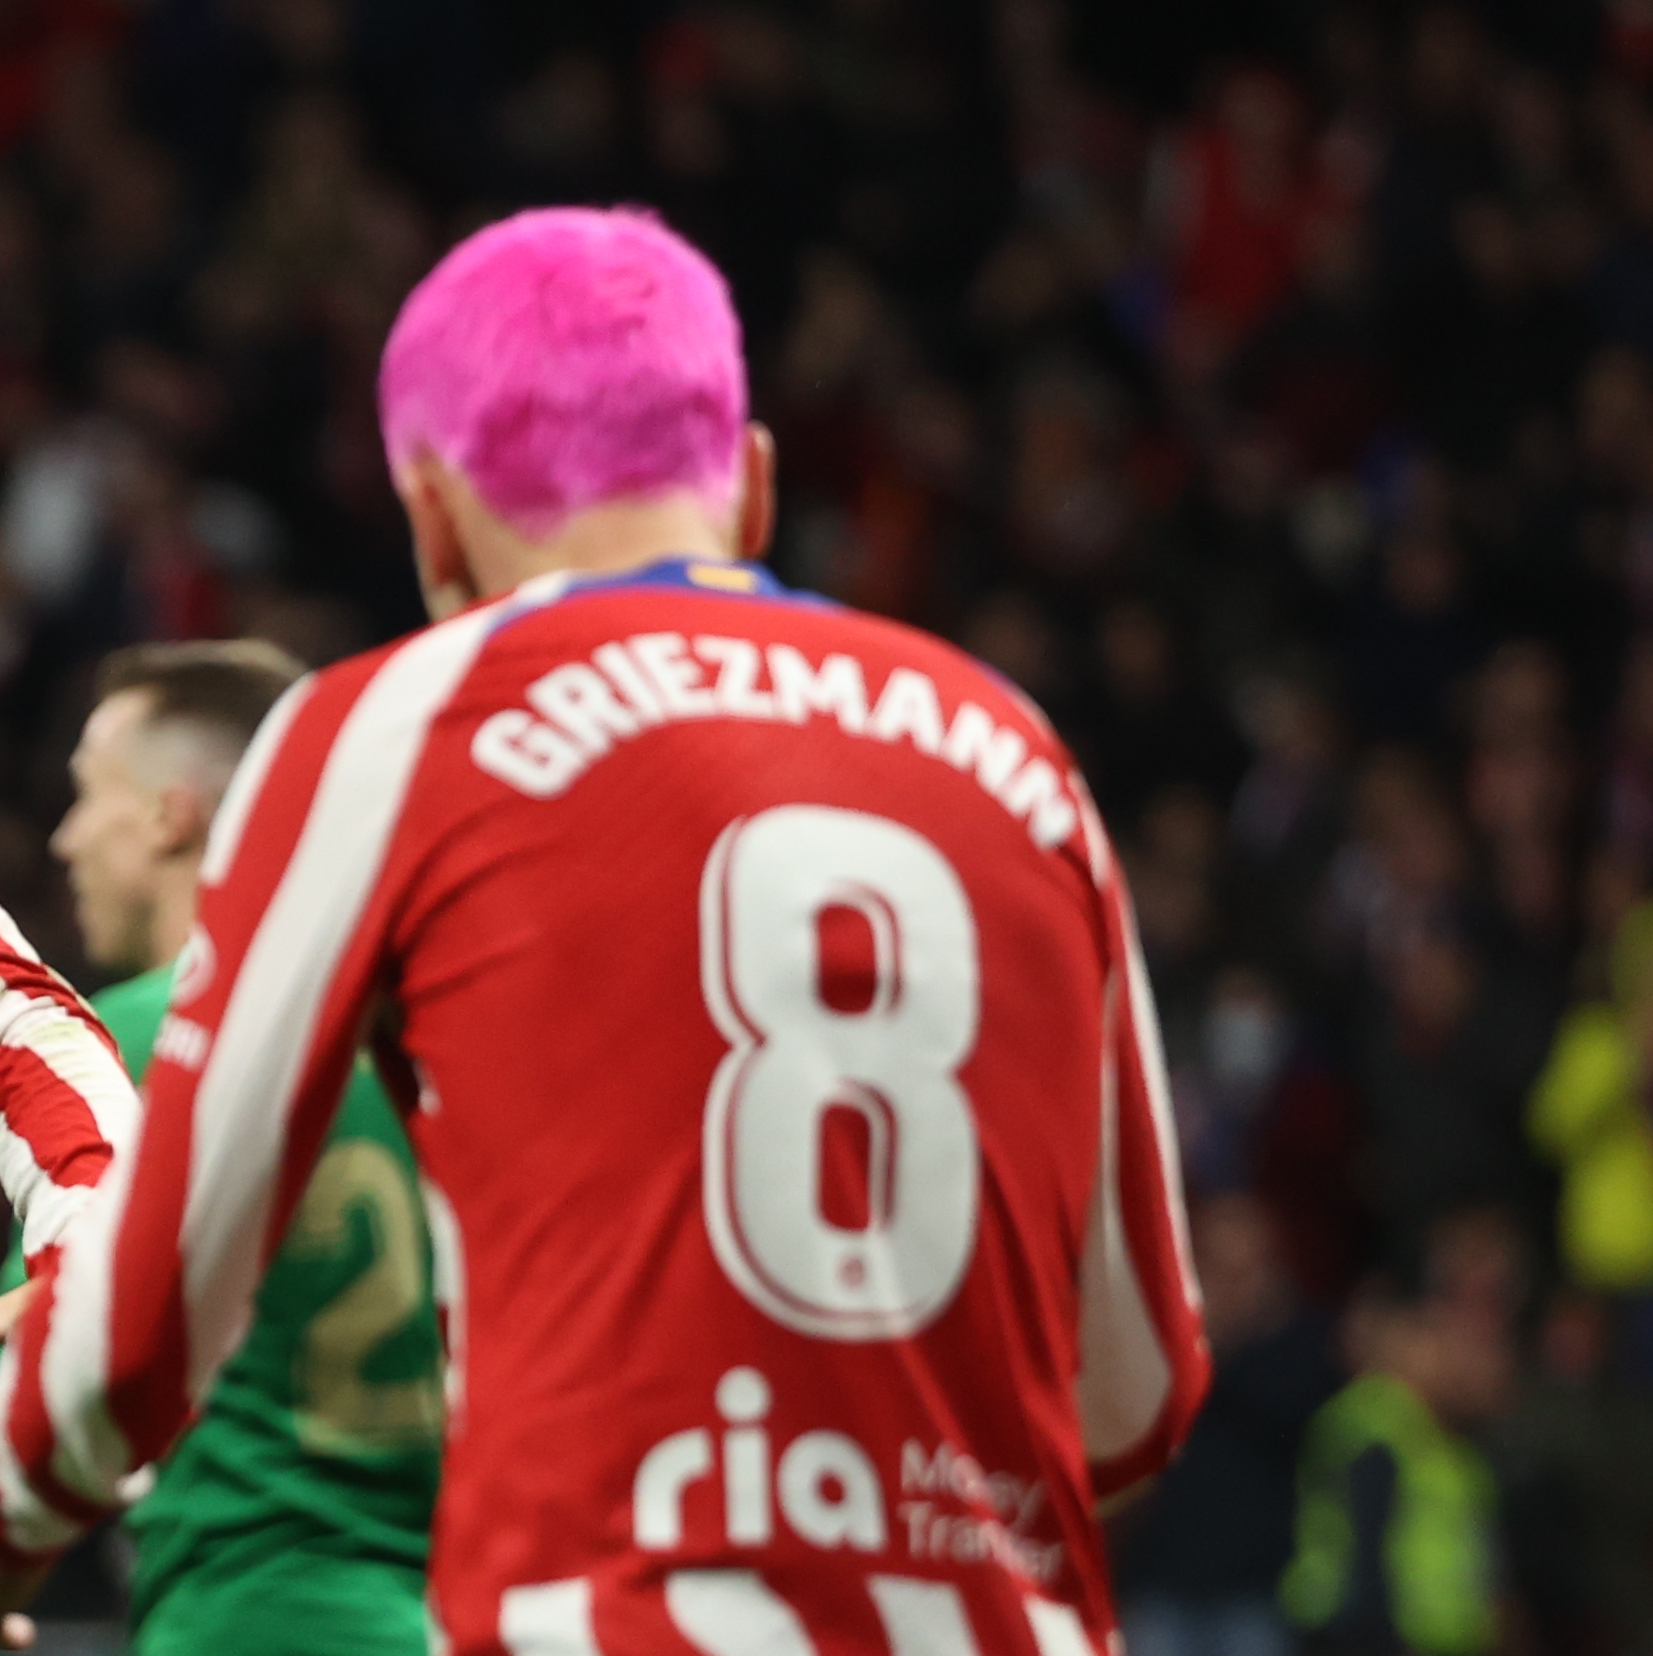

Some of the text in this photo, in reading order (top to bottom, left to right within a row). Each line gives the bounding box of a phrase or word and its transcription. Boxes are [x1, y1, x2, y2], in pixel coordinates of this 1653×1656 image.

[471, 630, 1076, 848] GRIEZMANN
[700, 802, 981, 1342] 8
[633, 1364, 887, 1553] ria
